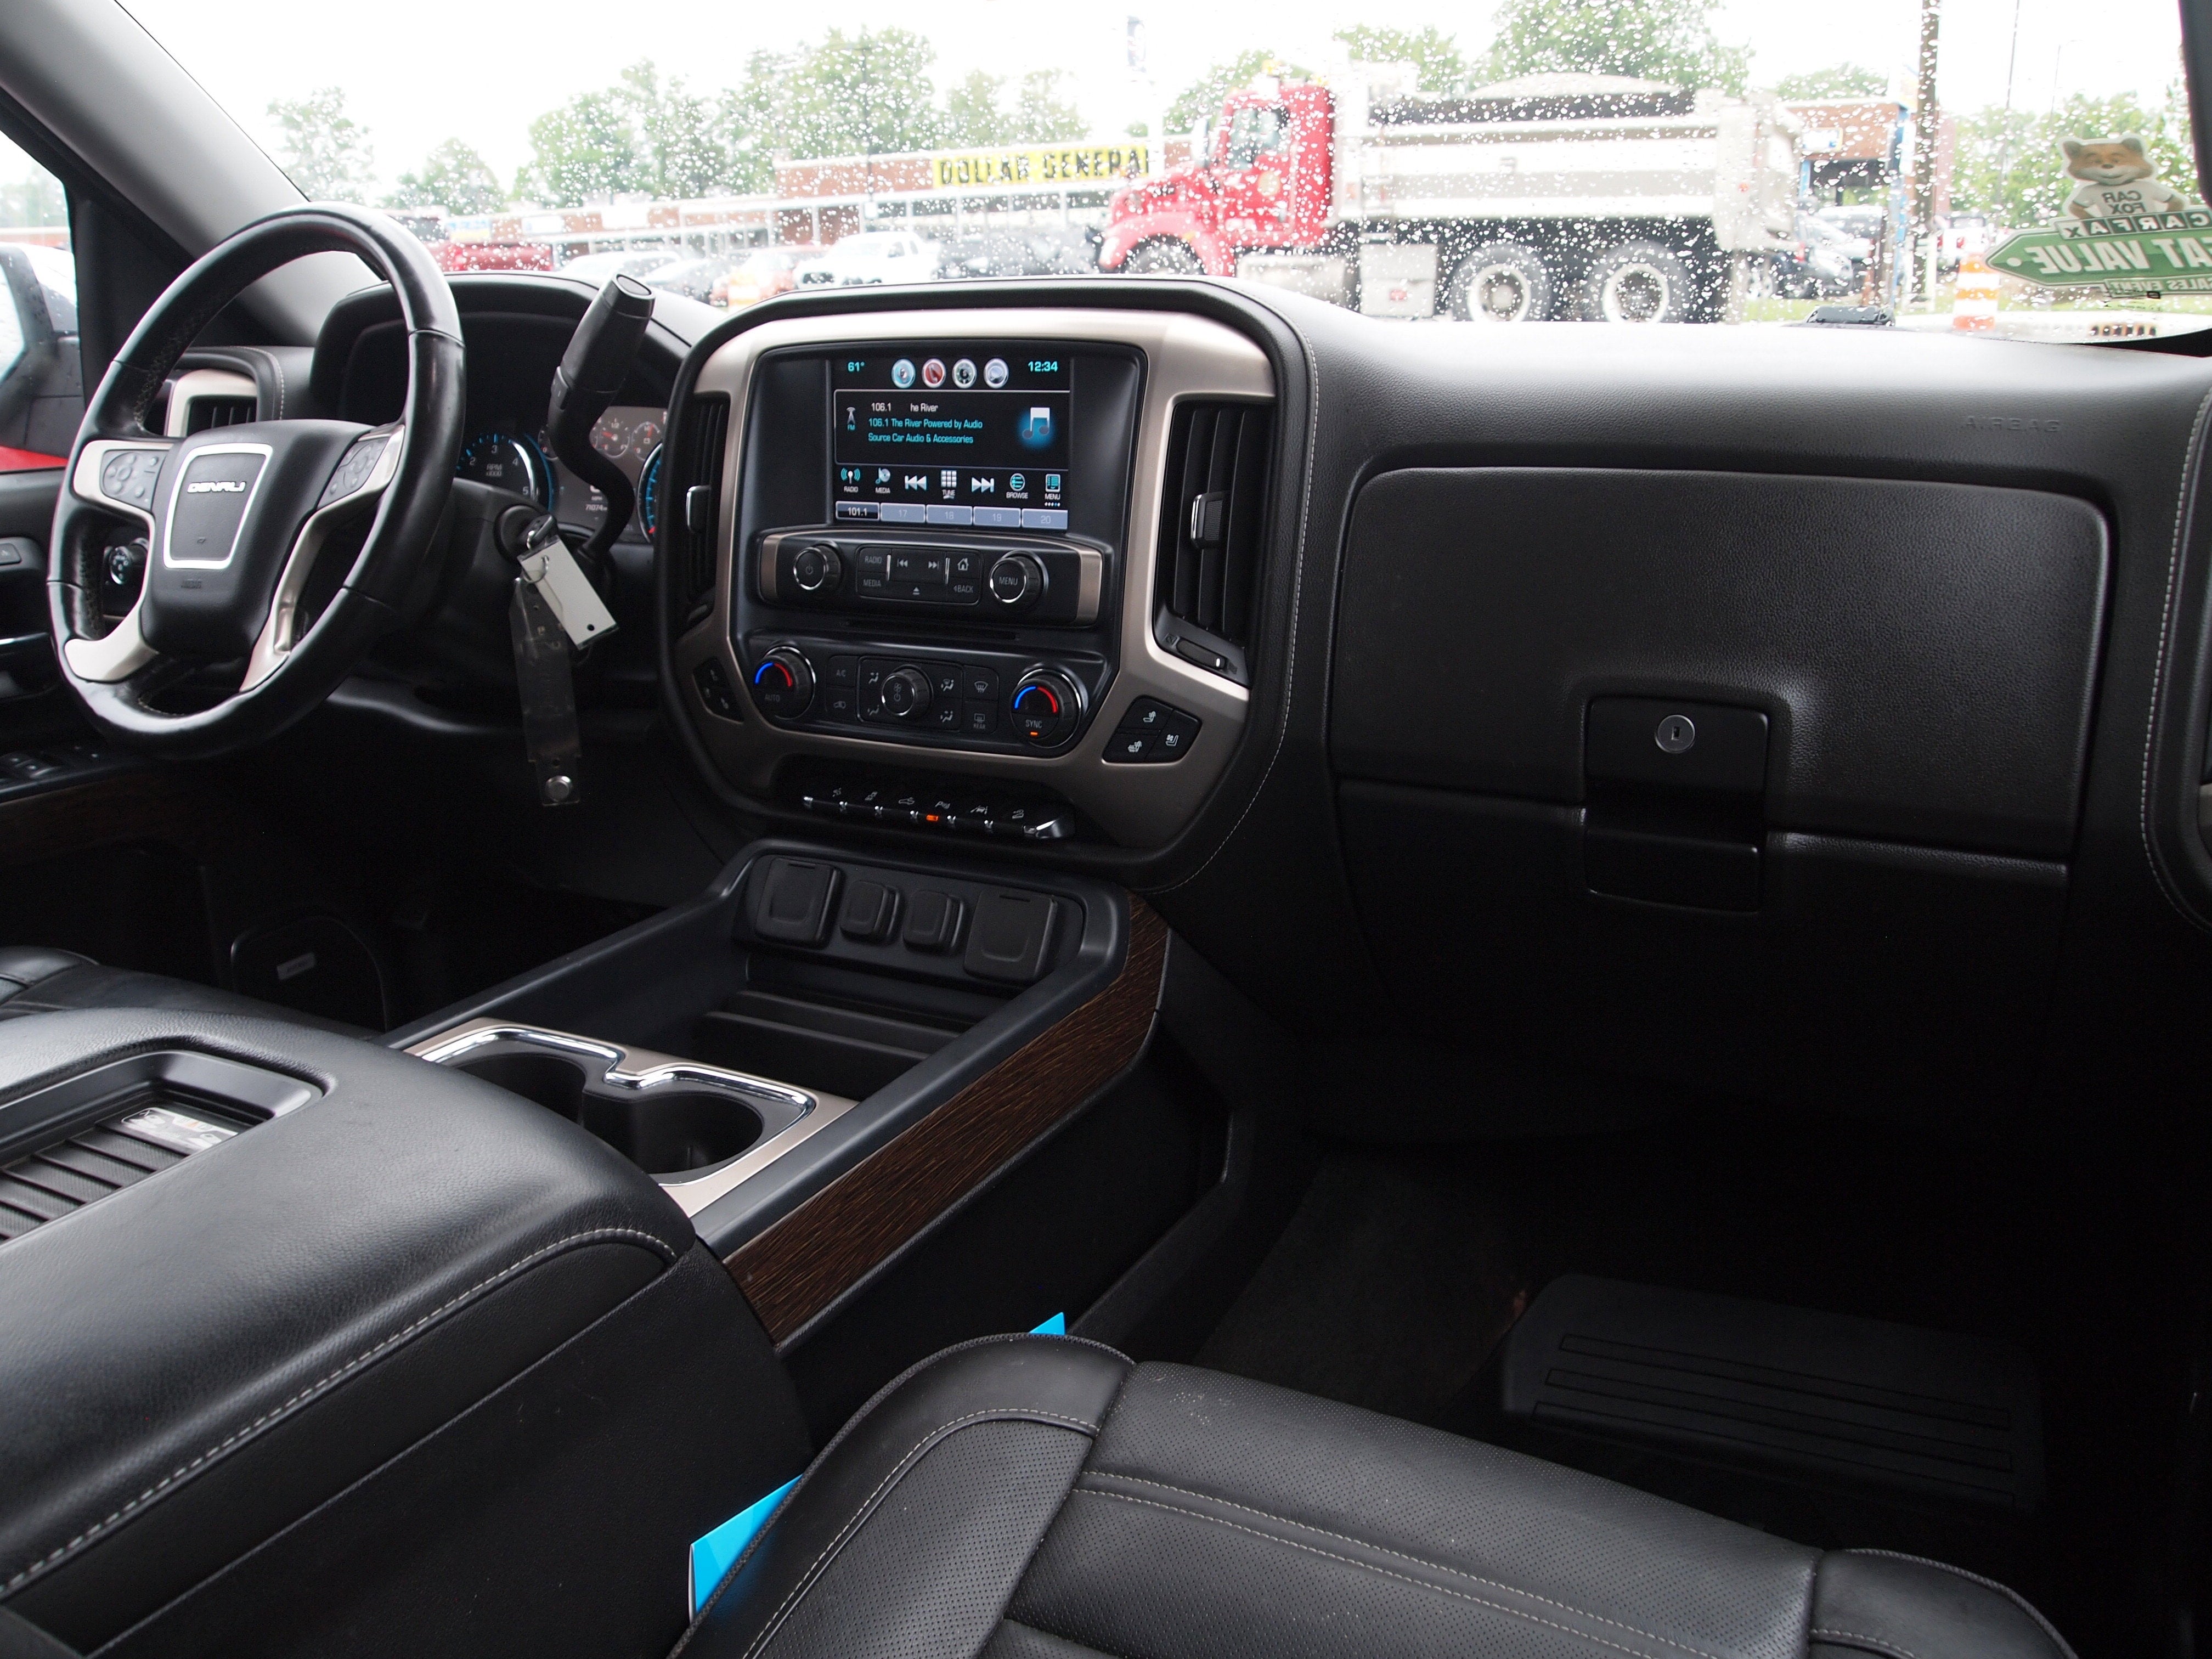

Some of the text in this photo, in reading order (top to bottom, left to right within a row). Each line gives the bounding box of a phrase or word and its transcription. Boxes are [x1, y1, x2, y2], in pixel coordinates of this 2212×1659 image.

[939, 155, 1029, 185] DOLLAR
[847, 361, 865, 372] 61°
[1028, 360, 1058, 373] 12:34
[871, 402, 891, 412] 106.1
[920, 403, 939, 413] River
[868, 417, 983, 430] 106.1 The River Powered by Audio
[868, 432, 974, 444] Source Car Audio & Accessories
[491, 444, 498, 454] 3
[469, 457, 476, 465] 2
[512, 458, 518, 466] 4
[187, 481, 246, 493] DENALI
[522, 486, 529, 495] 5
[847, 507, 867, 516] 101.1
[898, 509, 907, 518] 17
[1040, 515, 1051, 524] 20
[864, 555, 882, 564] RADIO
[863, 579, 881, 588] MEDIA
[998, 577, 1018, 586] MENU
[957, 585, 974, 593] BACK
[1025, 719, 1042, 729] SYNC
